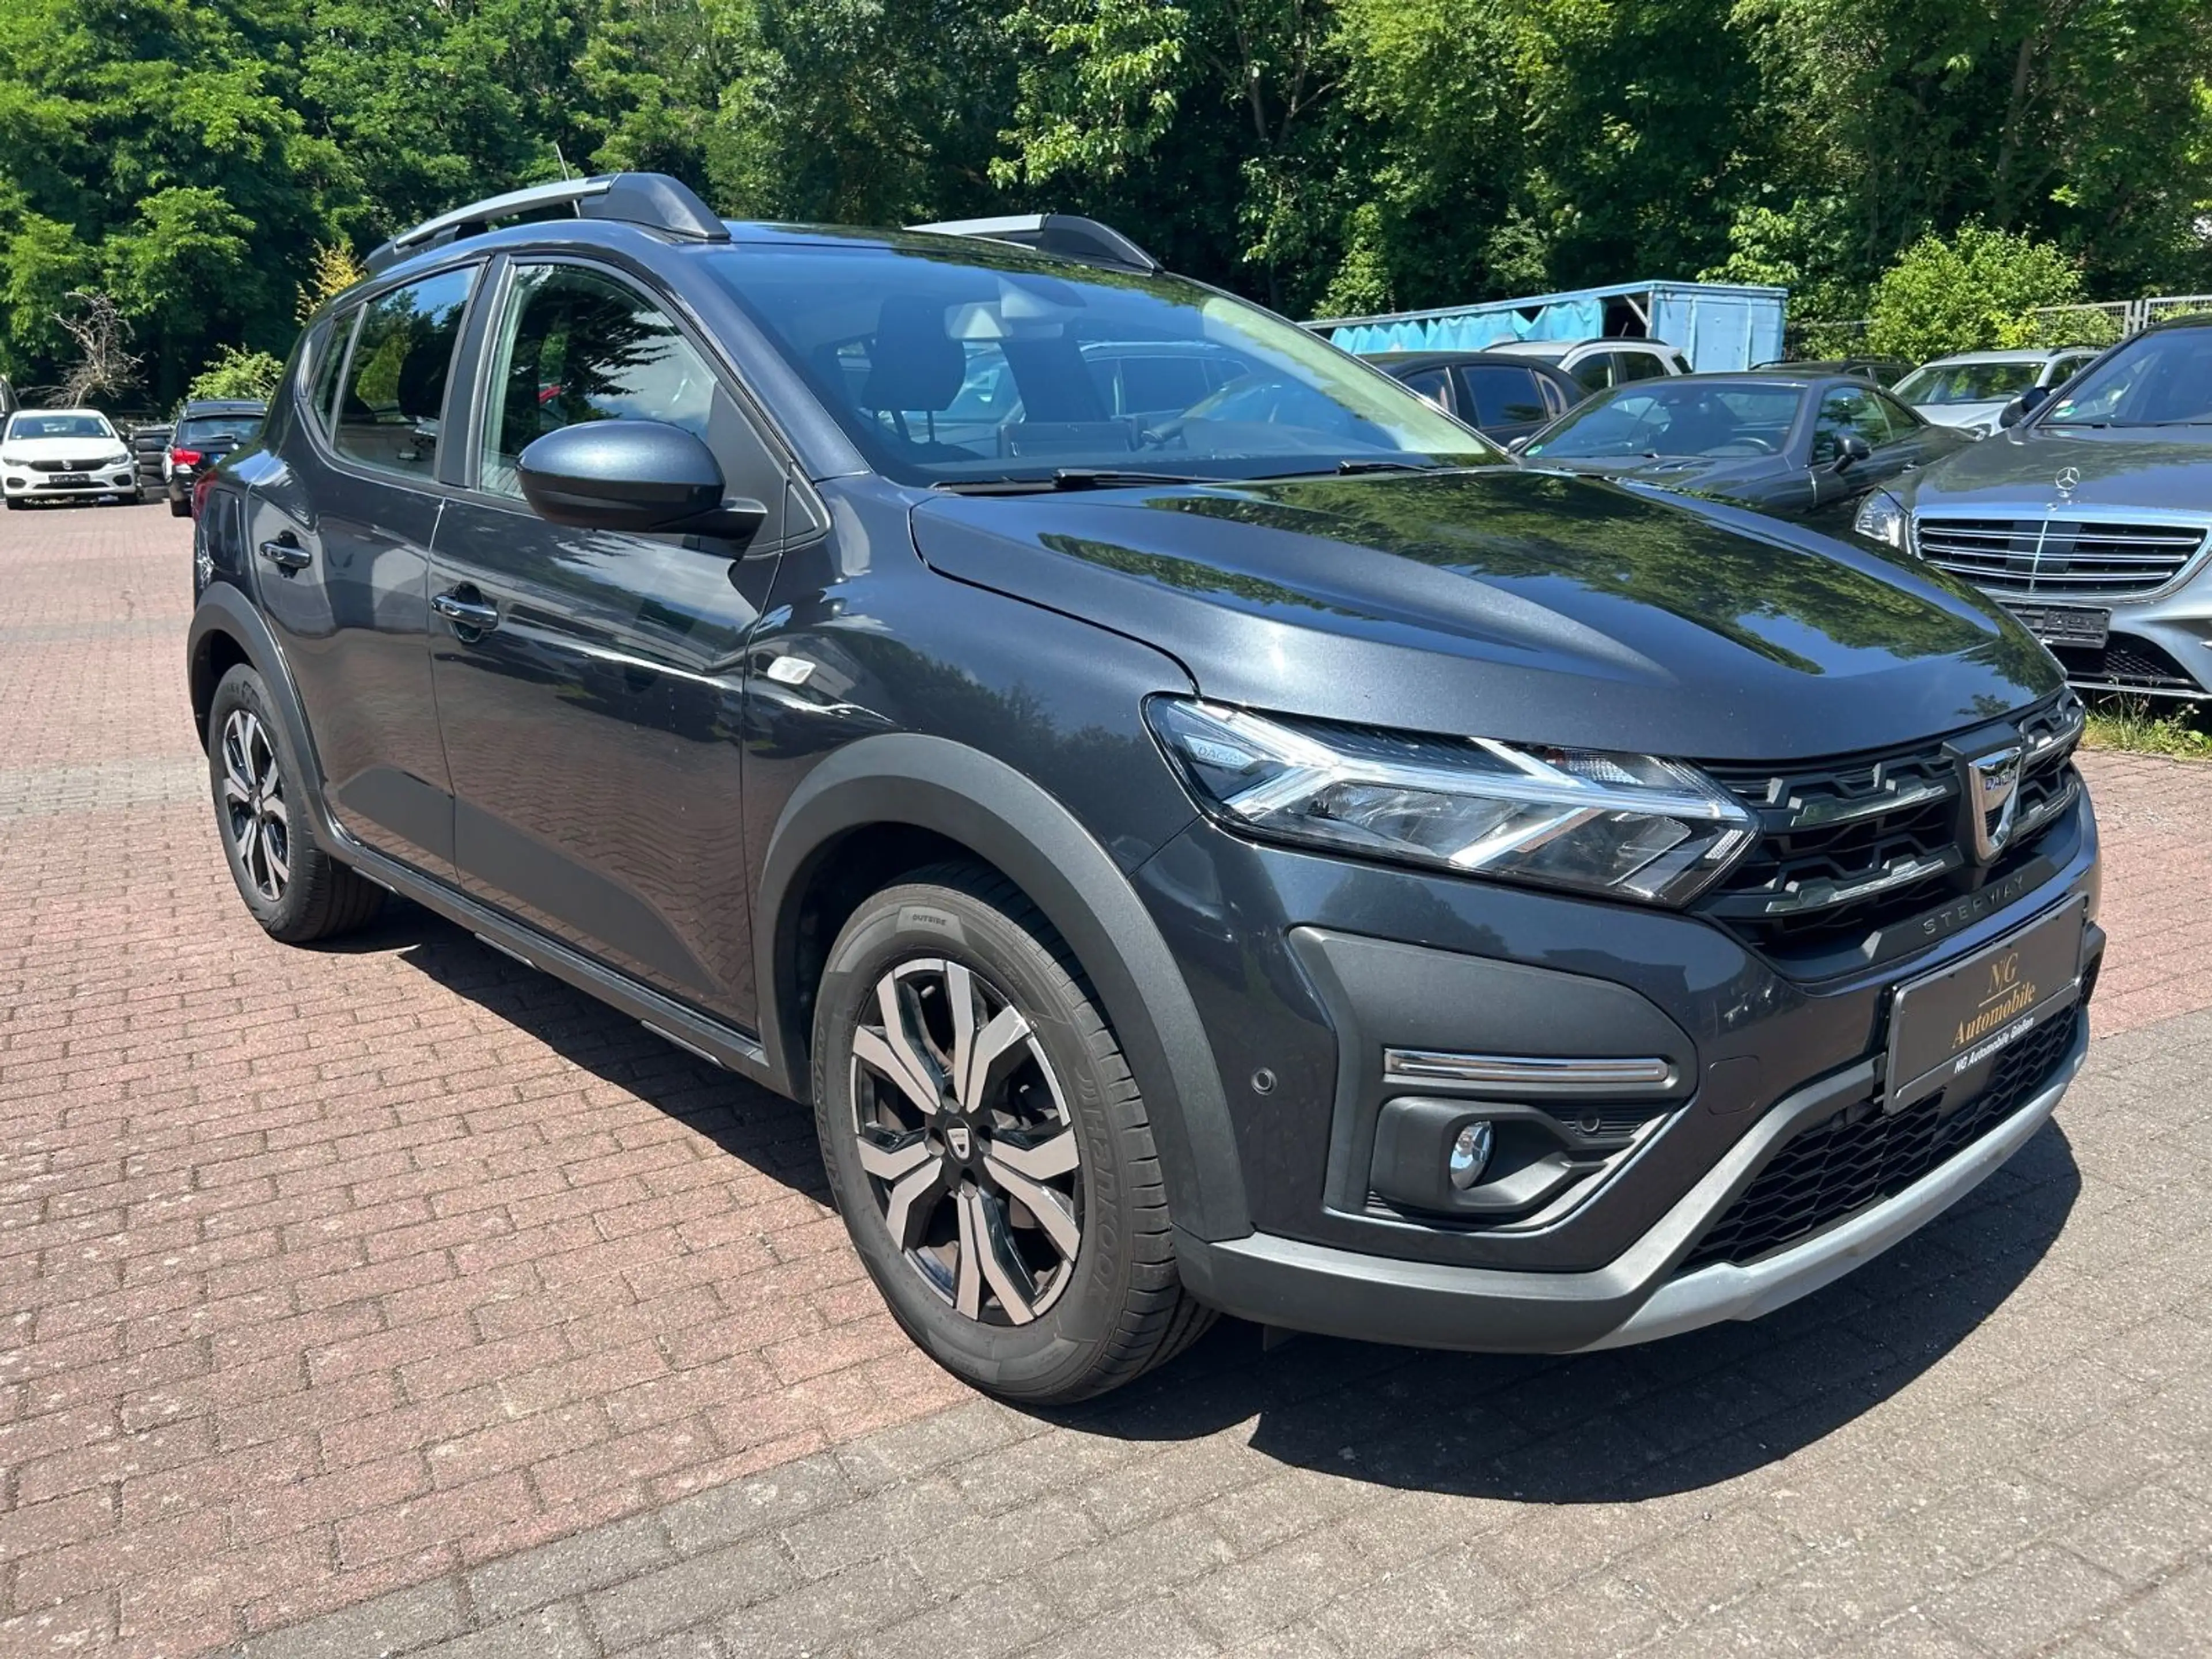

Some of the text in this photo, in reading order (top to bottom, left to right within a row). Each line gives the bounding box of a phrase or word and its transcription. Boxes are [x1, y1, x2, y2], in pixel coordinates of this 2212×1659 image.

[912, 913, 947, 926] OUTSIDE
[1923, 874, 2023, 935] STEPWAY
[1987, 952, 2018, 994] NG
[1952, 981, 2036, 1049] Automobile
